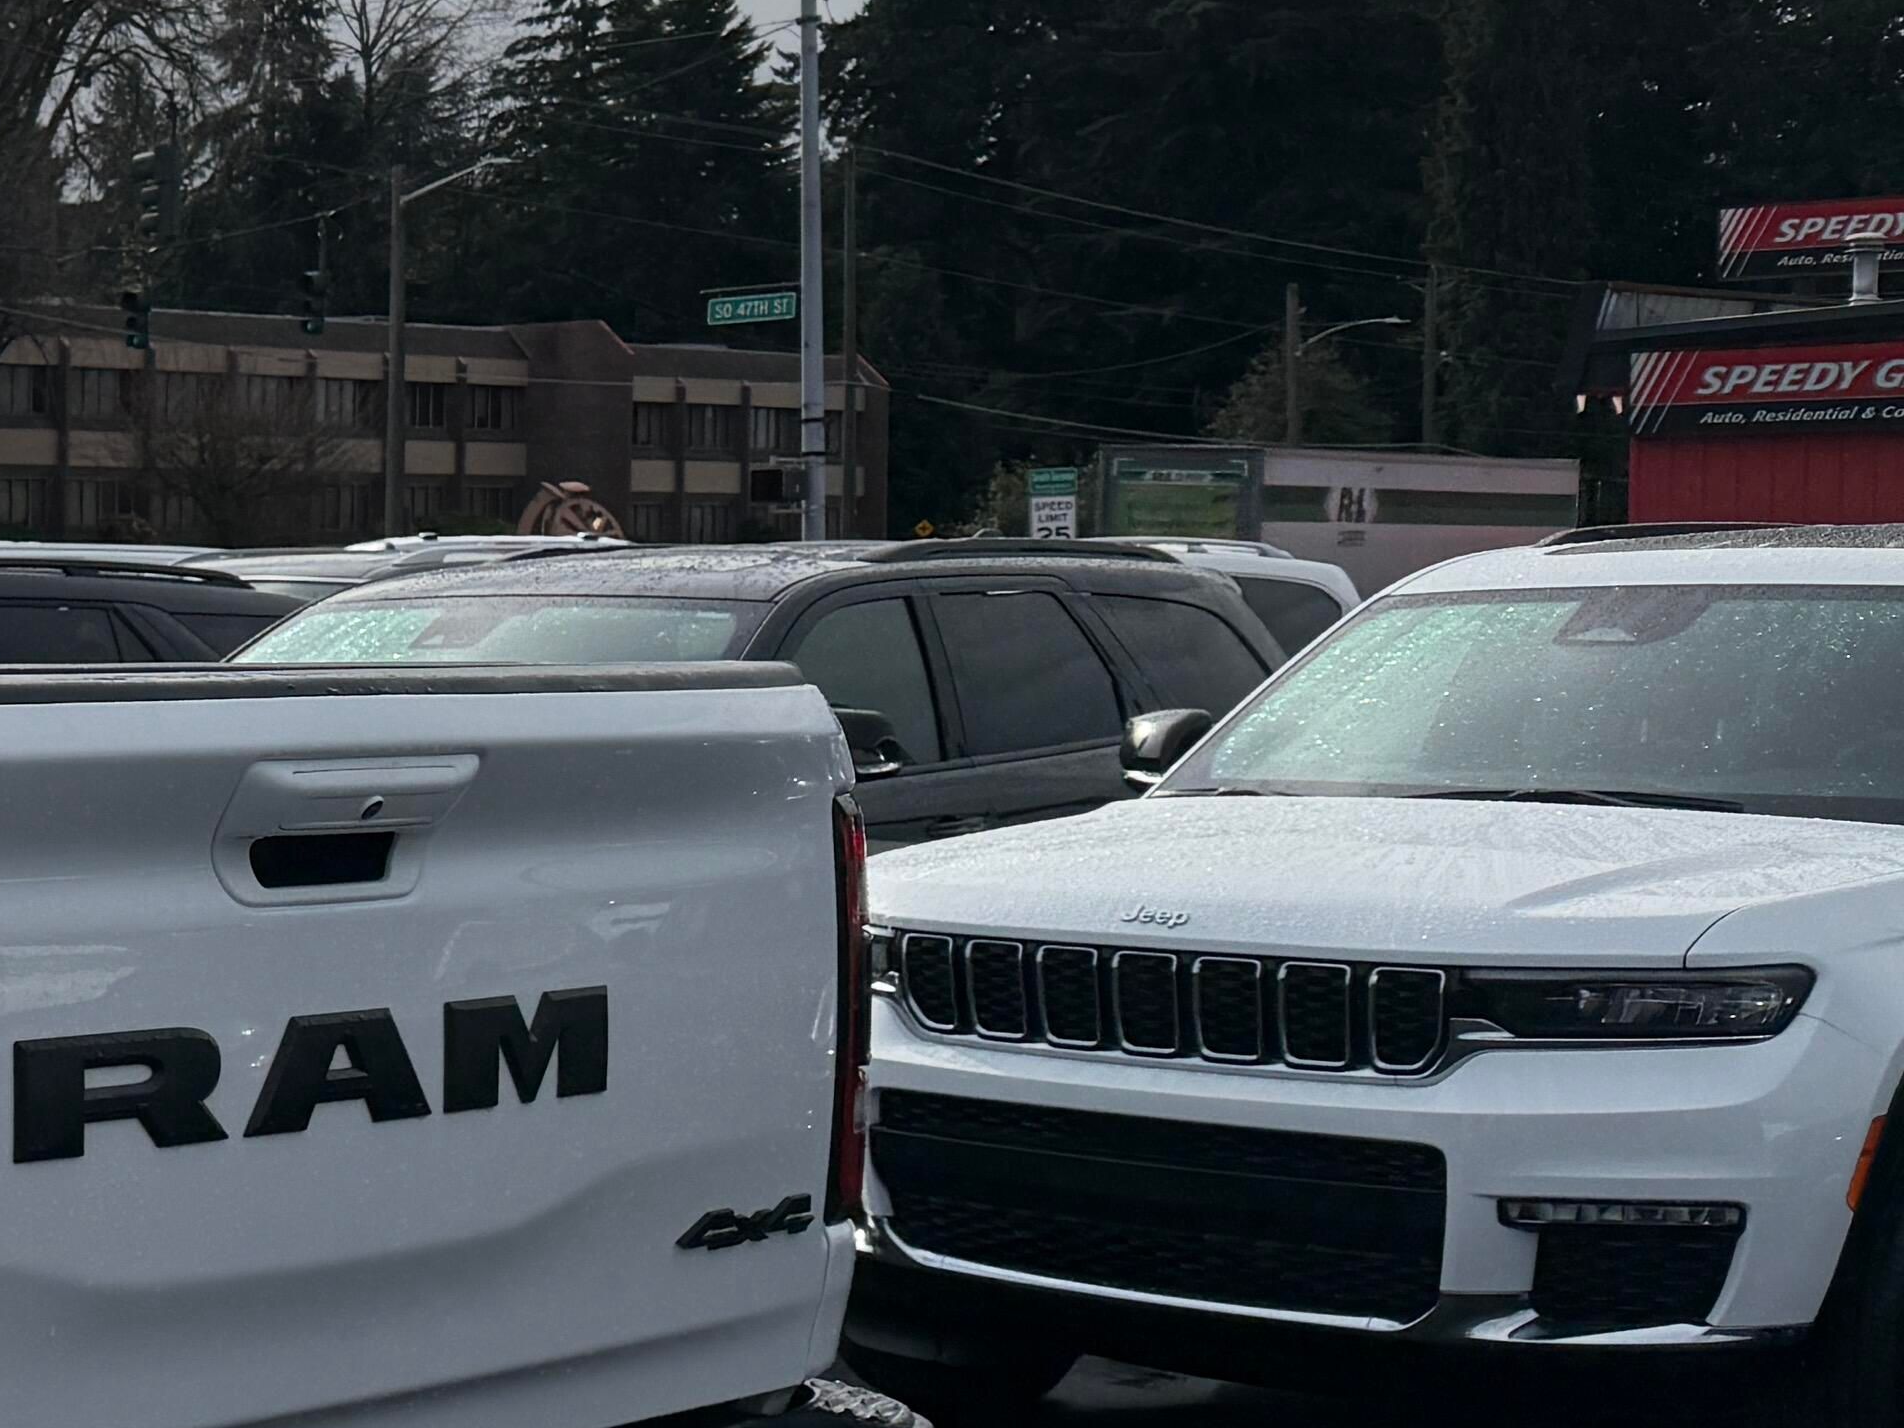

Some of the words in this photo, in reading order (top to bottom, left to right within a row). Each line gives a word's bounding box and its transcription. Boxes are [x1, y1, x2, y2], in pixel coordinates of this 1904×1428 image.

[714, 302, 733, 319] SO
[737, 300, 769, 317] 47TH
[773, 298, 789, 314] ST
[1695, 360, 1872, 395] SPEEDY
[1700, 411, 1747, 425] Auto,
[1751, 406, 1859, 422] Residential
[1861, 406, 1876, 419] &
[1034, 501, 1073, 513] SPEED
[1038, 512, 1068, 524] LIMIT
[1037, 526, 1071, 539] 25
[1120, 903, 1190, 929] Jeep
[13, 984, 609, 1164] RAM
